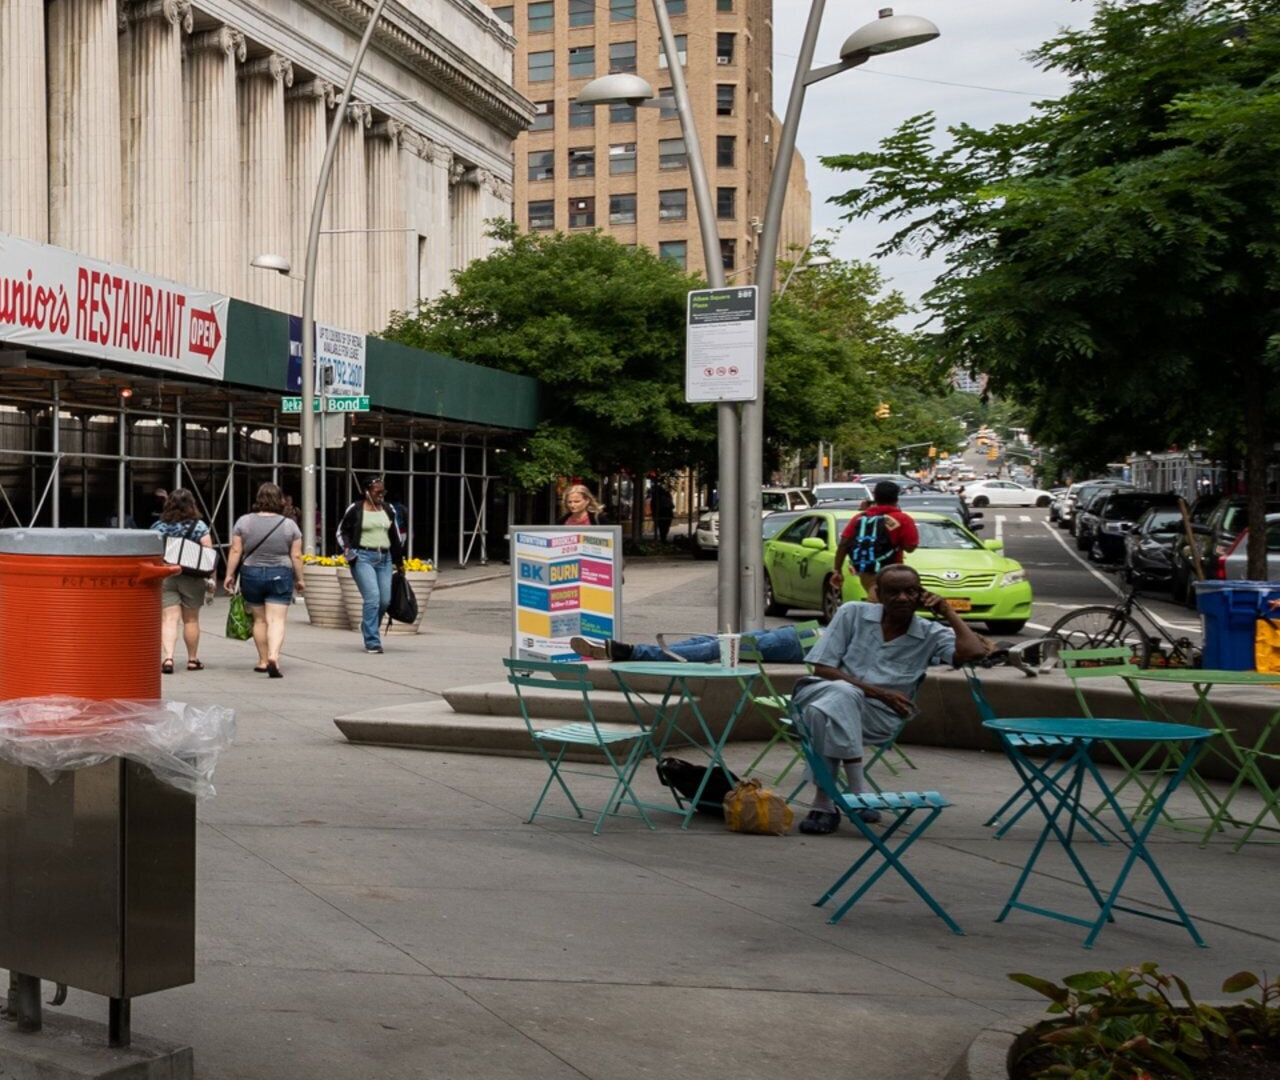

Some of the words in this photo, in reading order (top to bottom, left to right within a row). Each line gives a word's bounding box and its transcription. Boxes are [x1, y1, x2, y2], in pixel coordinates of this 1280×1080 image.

[76, 267, 186, 359] RESTAURANT
[191, 316, 216, 349] OPEN
[329, 398, 359, 410] Bond
[521, 563, 544, 581] BK
[550, 563, 579, 581] BURN
